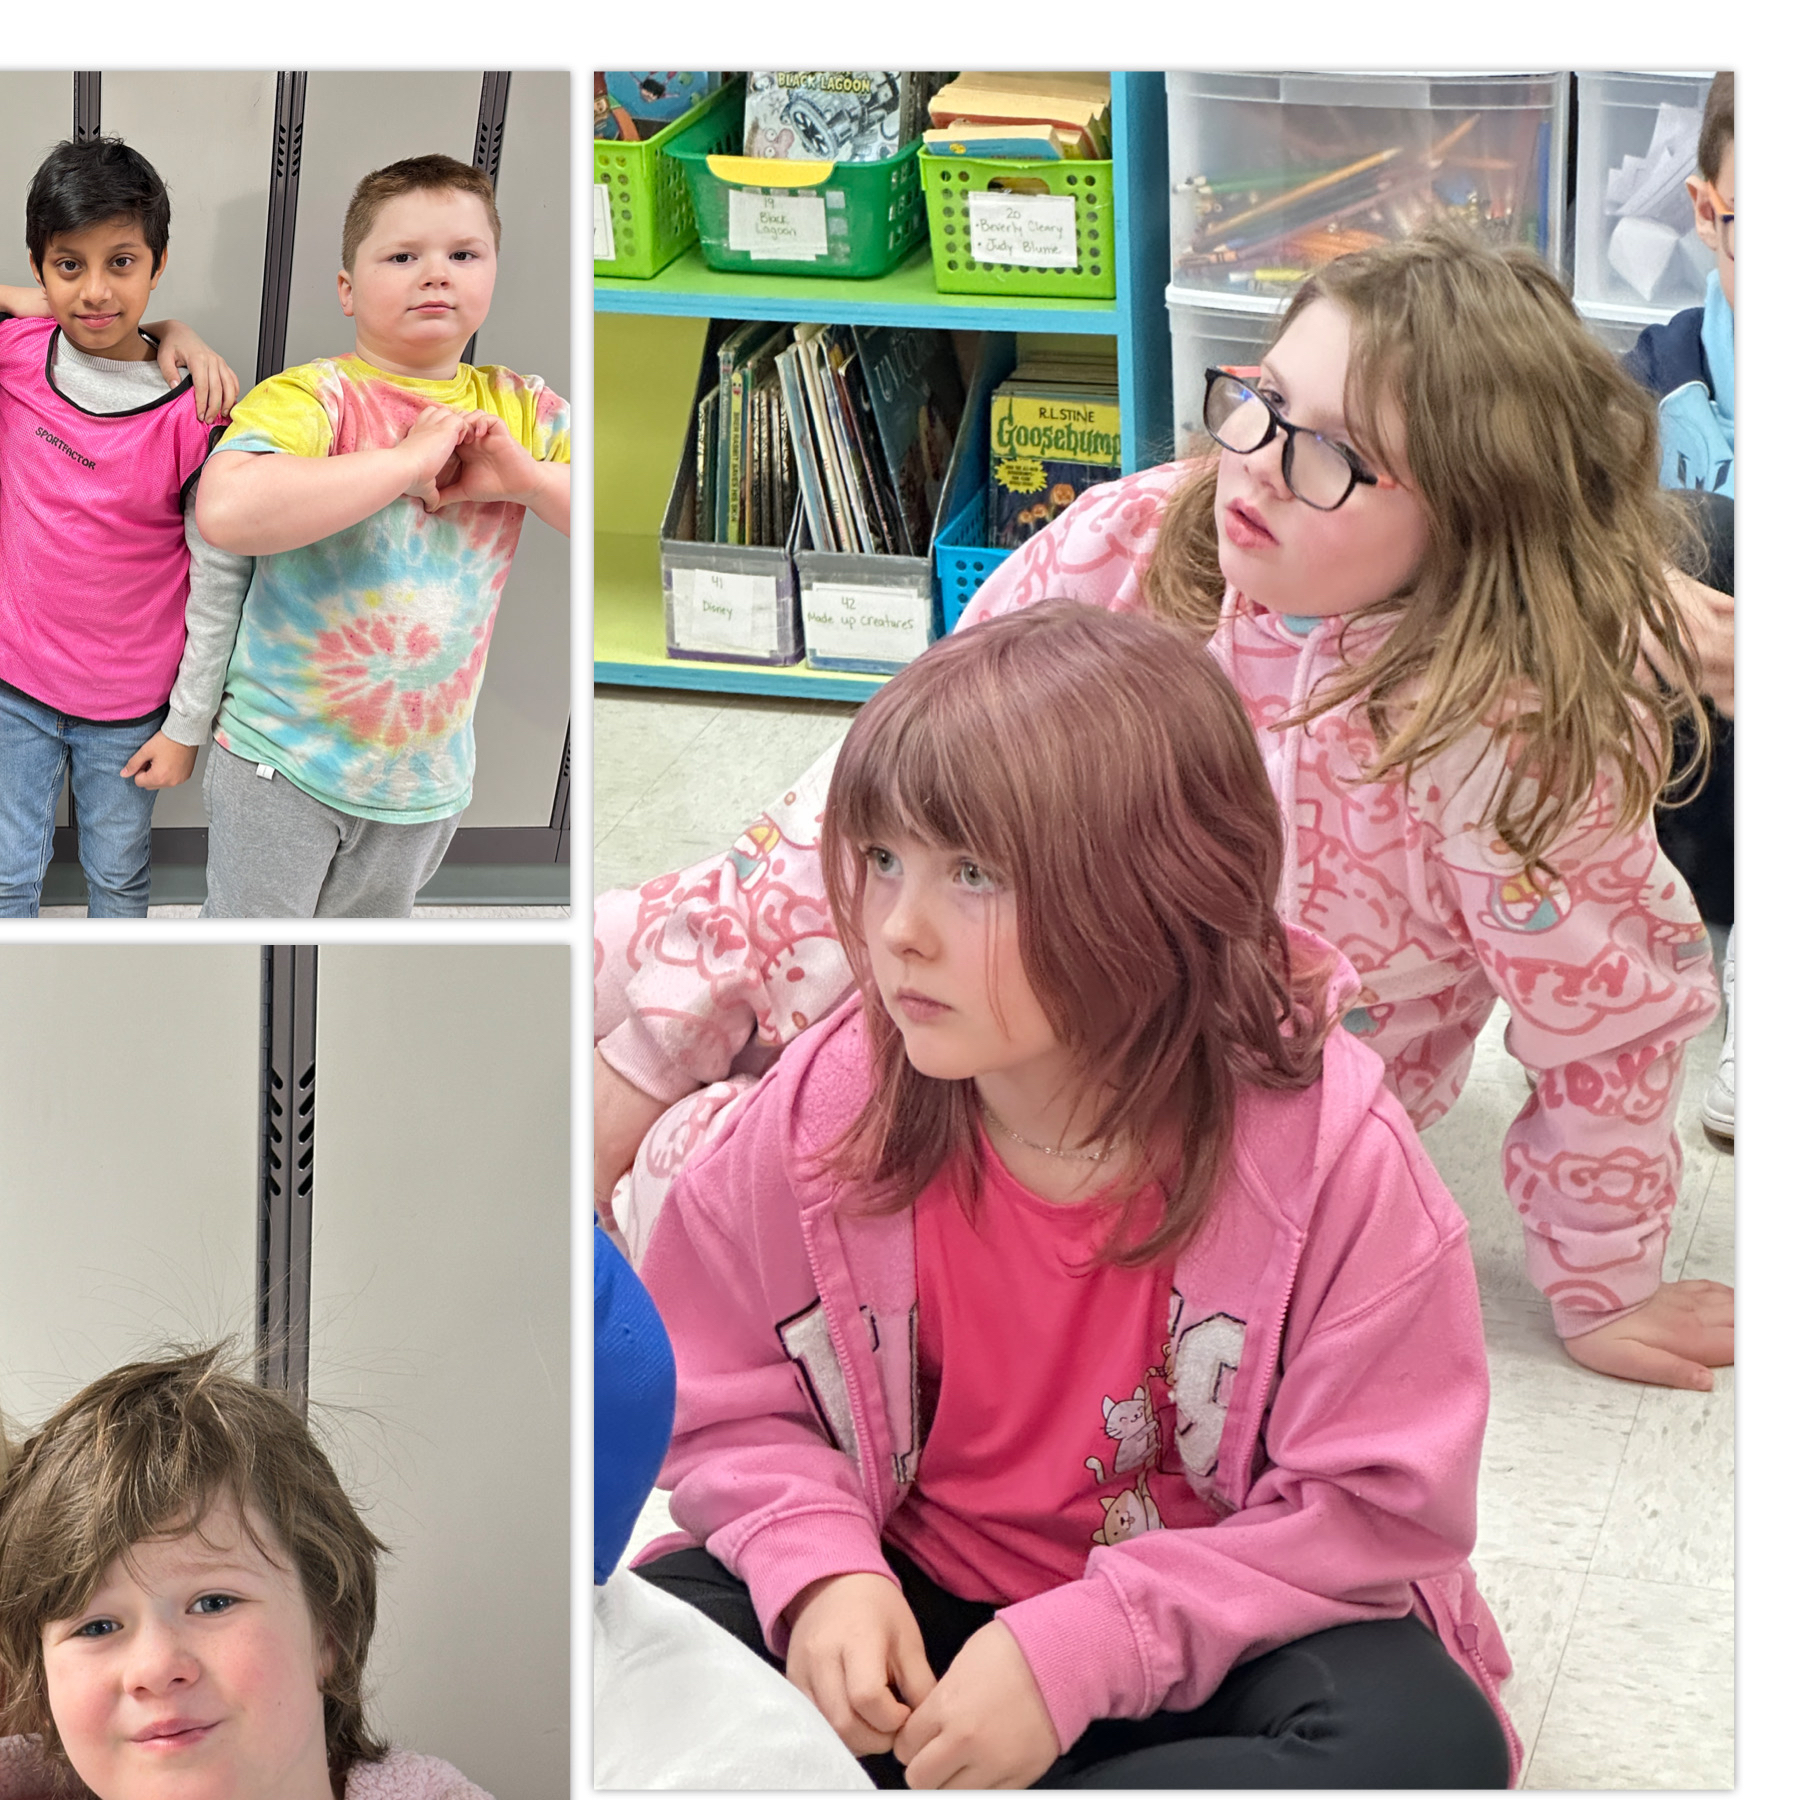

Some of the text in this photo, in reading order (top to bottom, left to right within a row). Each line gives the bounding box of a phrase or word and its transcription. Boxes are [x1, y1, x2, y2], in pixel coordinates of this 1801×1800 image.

[778, 72, 870, 92] BLACK LAGOON
[760, 212, 786, 224] Black
[1006, 208, 1021, 219] 20
[756, 223, 796, 239] Lagoon
[1028, 221, 1063, 239] Cleary
[987, 239, 1061, 256] Judy Blume
[997, 397, 1121, 468] Goosebump
[35, 426, 97, 470] SPORTFACTOR
[703, 600, 733, 619] Disney
[841, 598, 856, 610] 42
[808, 612, 834, 625] Made
[841, 616, 856, 629] up
